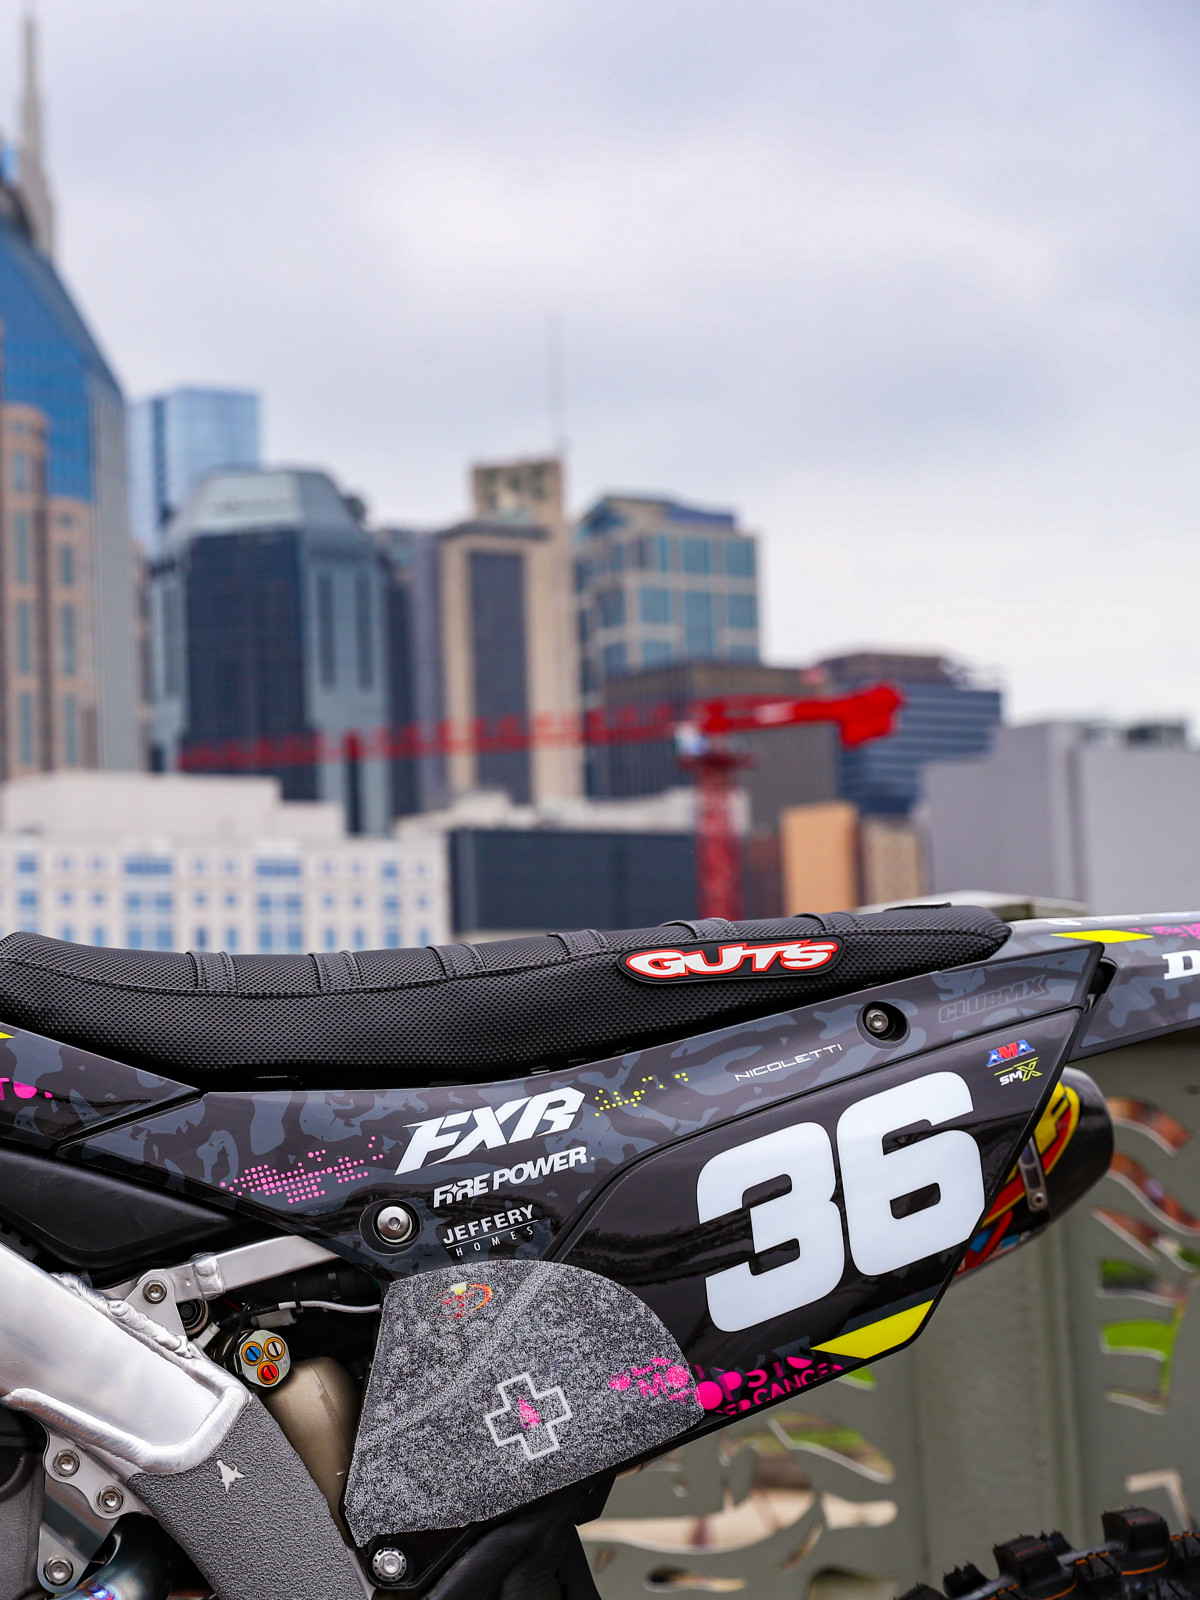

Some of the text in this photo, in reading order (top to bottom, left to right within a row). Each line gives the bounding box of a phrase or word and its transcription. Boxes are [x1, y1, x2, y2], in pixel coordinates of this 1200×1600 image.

[626, 940, 838, 978] GUTS
[734, 1043, 843, 1082] NICOLETTI
[986, 1039, 1035, 1067] AMA
[999, 1061, 1043, 1086] SMX
[394, 1086, 586, 1176] FXR
[433, 1145, 588, 1209] FIRE POWER
[696, 1071, 985, 1333] 36
[442, 1203, 534, 1244] JEFFERY
[455, 1226, 534, 1258] HOMES
